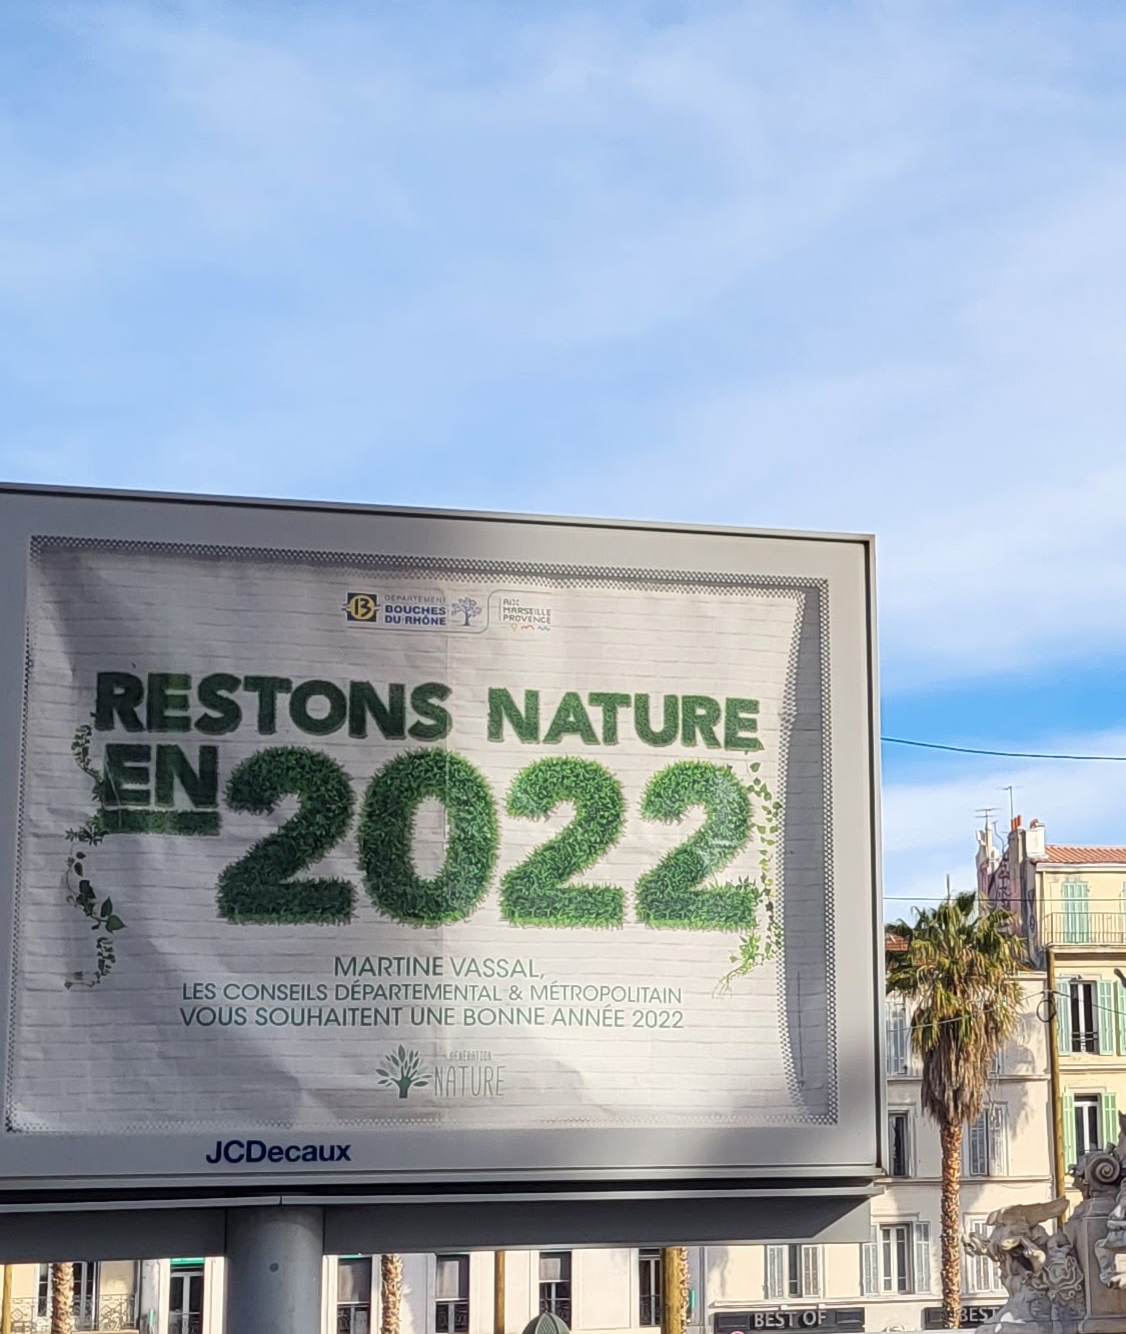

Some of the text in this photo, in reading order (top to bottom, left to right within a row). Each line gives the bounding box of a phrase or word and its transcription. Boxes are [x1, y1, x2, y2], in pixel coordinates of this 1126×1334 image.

[384, 604, 446, 615] BOUCHES
[384, 613, 447, 626] DU RHÔNE
[502, 606, 551, 616] MARSEILLE
[502, 614, 551, 625] PROVENCE
[95, 671, 765, 751] RESTONS NATURE
[102, 744, 760, 932] EN 2022
[334, 956, 545, 979] MARTINE VASSAL,
[183, 979, 682, 1004] LES CONSEILS DÉPARTEMENTAL & MÉTROPOLITAIN
[180, 1004, 684, 1028] VOUS SOUHAITENT UNE BONNE ANNÉE 2022
[434, 1065, 506, 1097] NATURE
[205, 1139, 352, 1164] JCDecaux
[754, 1309, 827, 1328] BEST OF
[960, 1307, 1000, 1322] BEST
